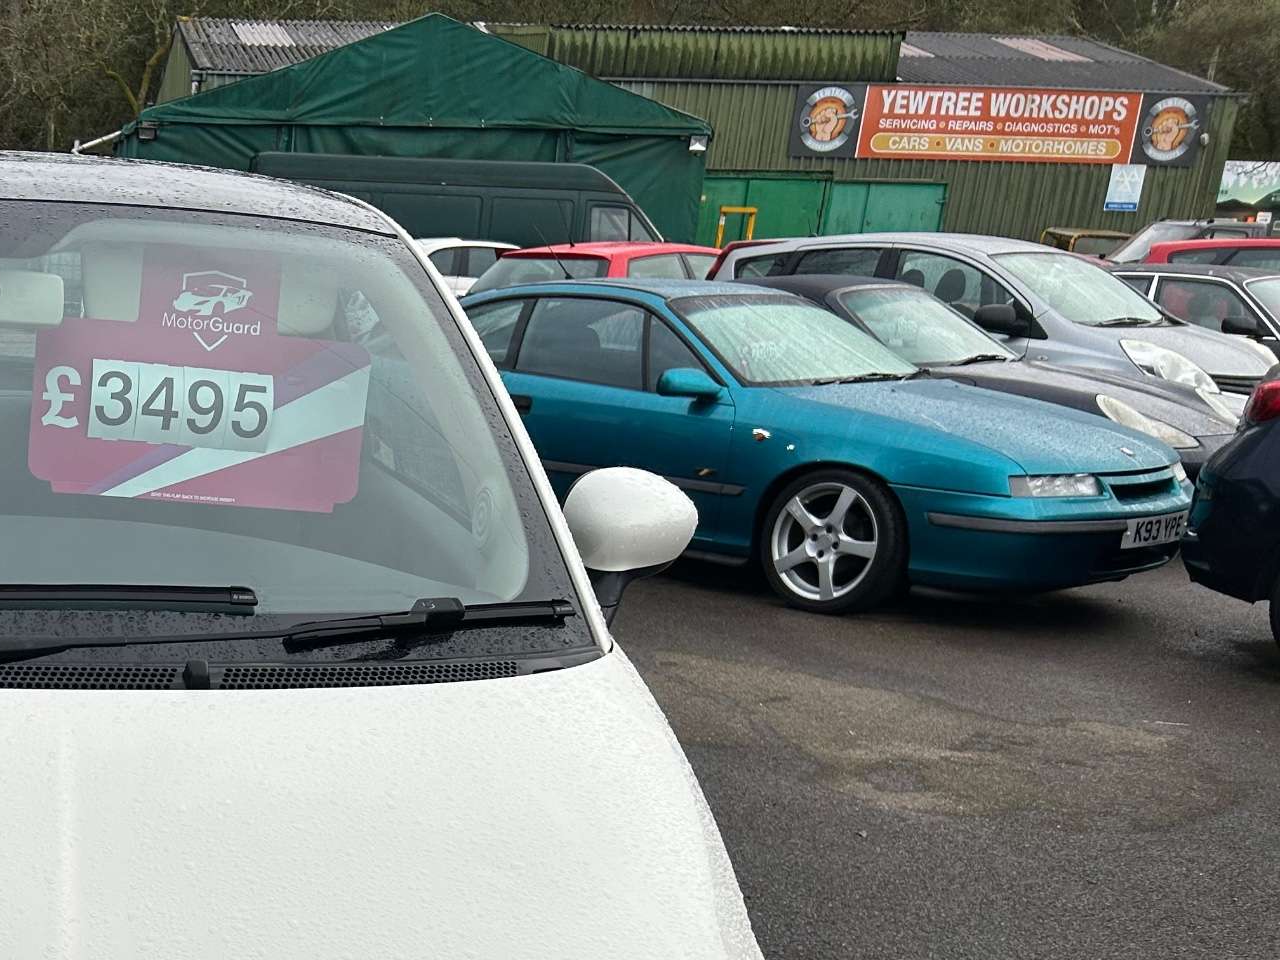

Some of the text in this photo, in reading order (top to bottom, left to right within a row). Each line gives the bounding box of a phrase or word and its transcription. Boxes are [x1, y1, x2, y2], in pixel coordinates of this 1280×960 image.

[881, 89, 985, 117] YEWTREE
[990, 92, 1129, 121] WORKSHOPS
[878, 118, 1120, 135] SERVICING REPAIRS DIAGNOSTICS MOT's
[888, 136, 1107, 155] CARS VANS MOTORHOMES
[162, 312, 261, 336] MotorGuard
[1133, 514, 1184, 543] K93 YPE
